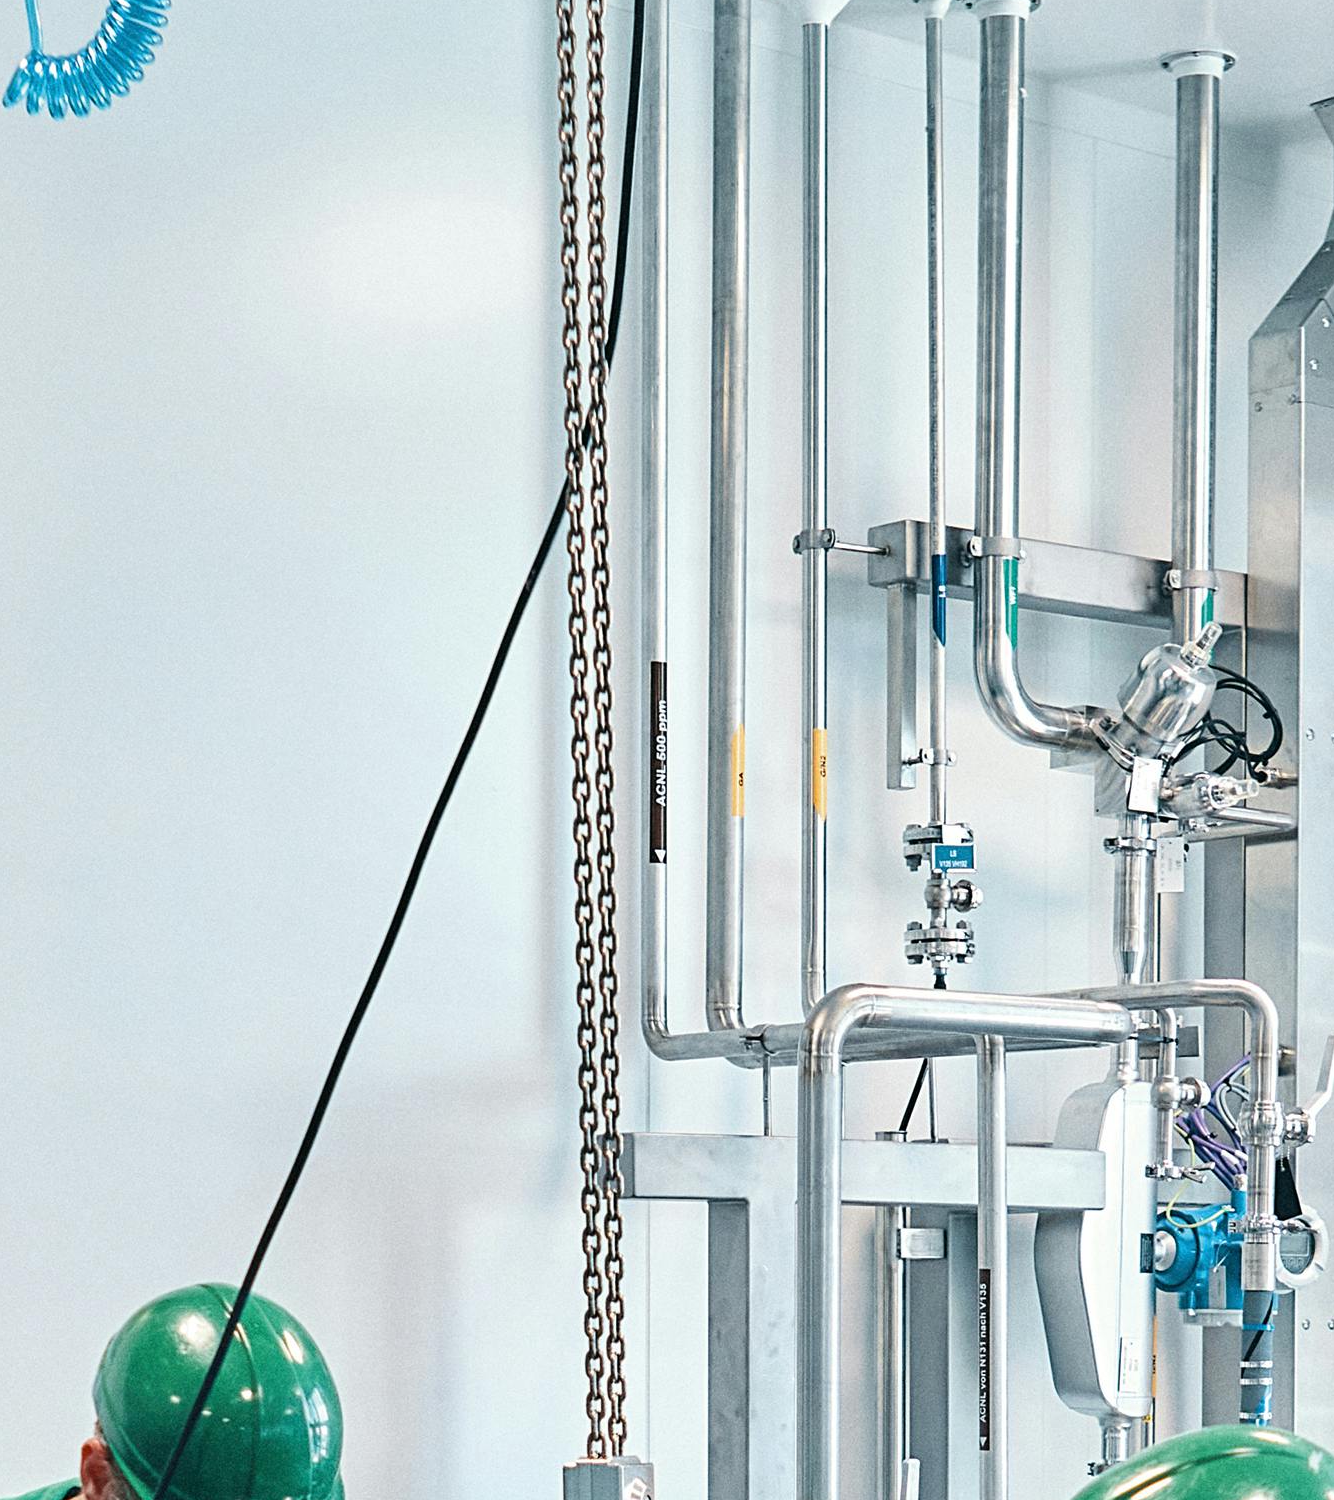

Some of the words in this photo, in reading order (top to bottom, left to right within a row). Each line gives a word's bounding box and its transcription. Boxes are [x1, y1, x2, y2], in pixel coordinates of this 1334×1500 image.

[656, 699, 668, 733] ppm
[655, 735, 667, 761] 500
[979, 1283, 988, 1309] V135
[979, 1311, 988, 1338] nach
[979, 1341, 988, 1368] N131
[980, 1370, 988, 1390] von
[979, 1392, 988, 1423] ACNL
